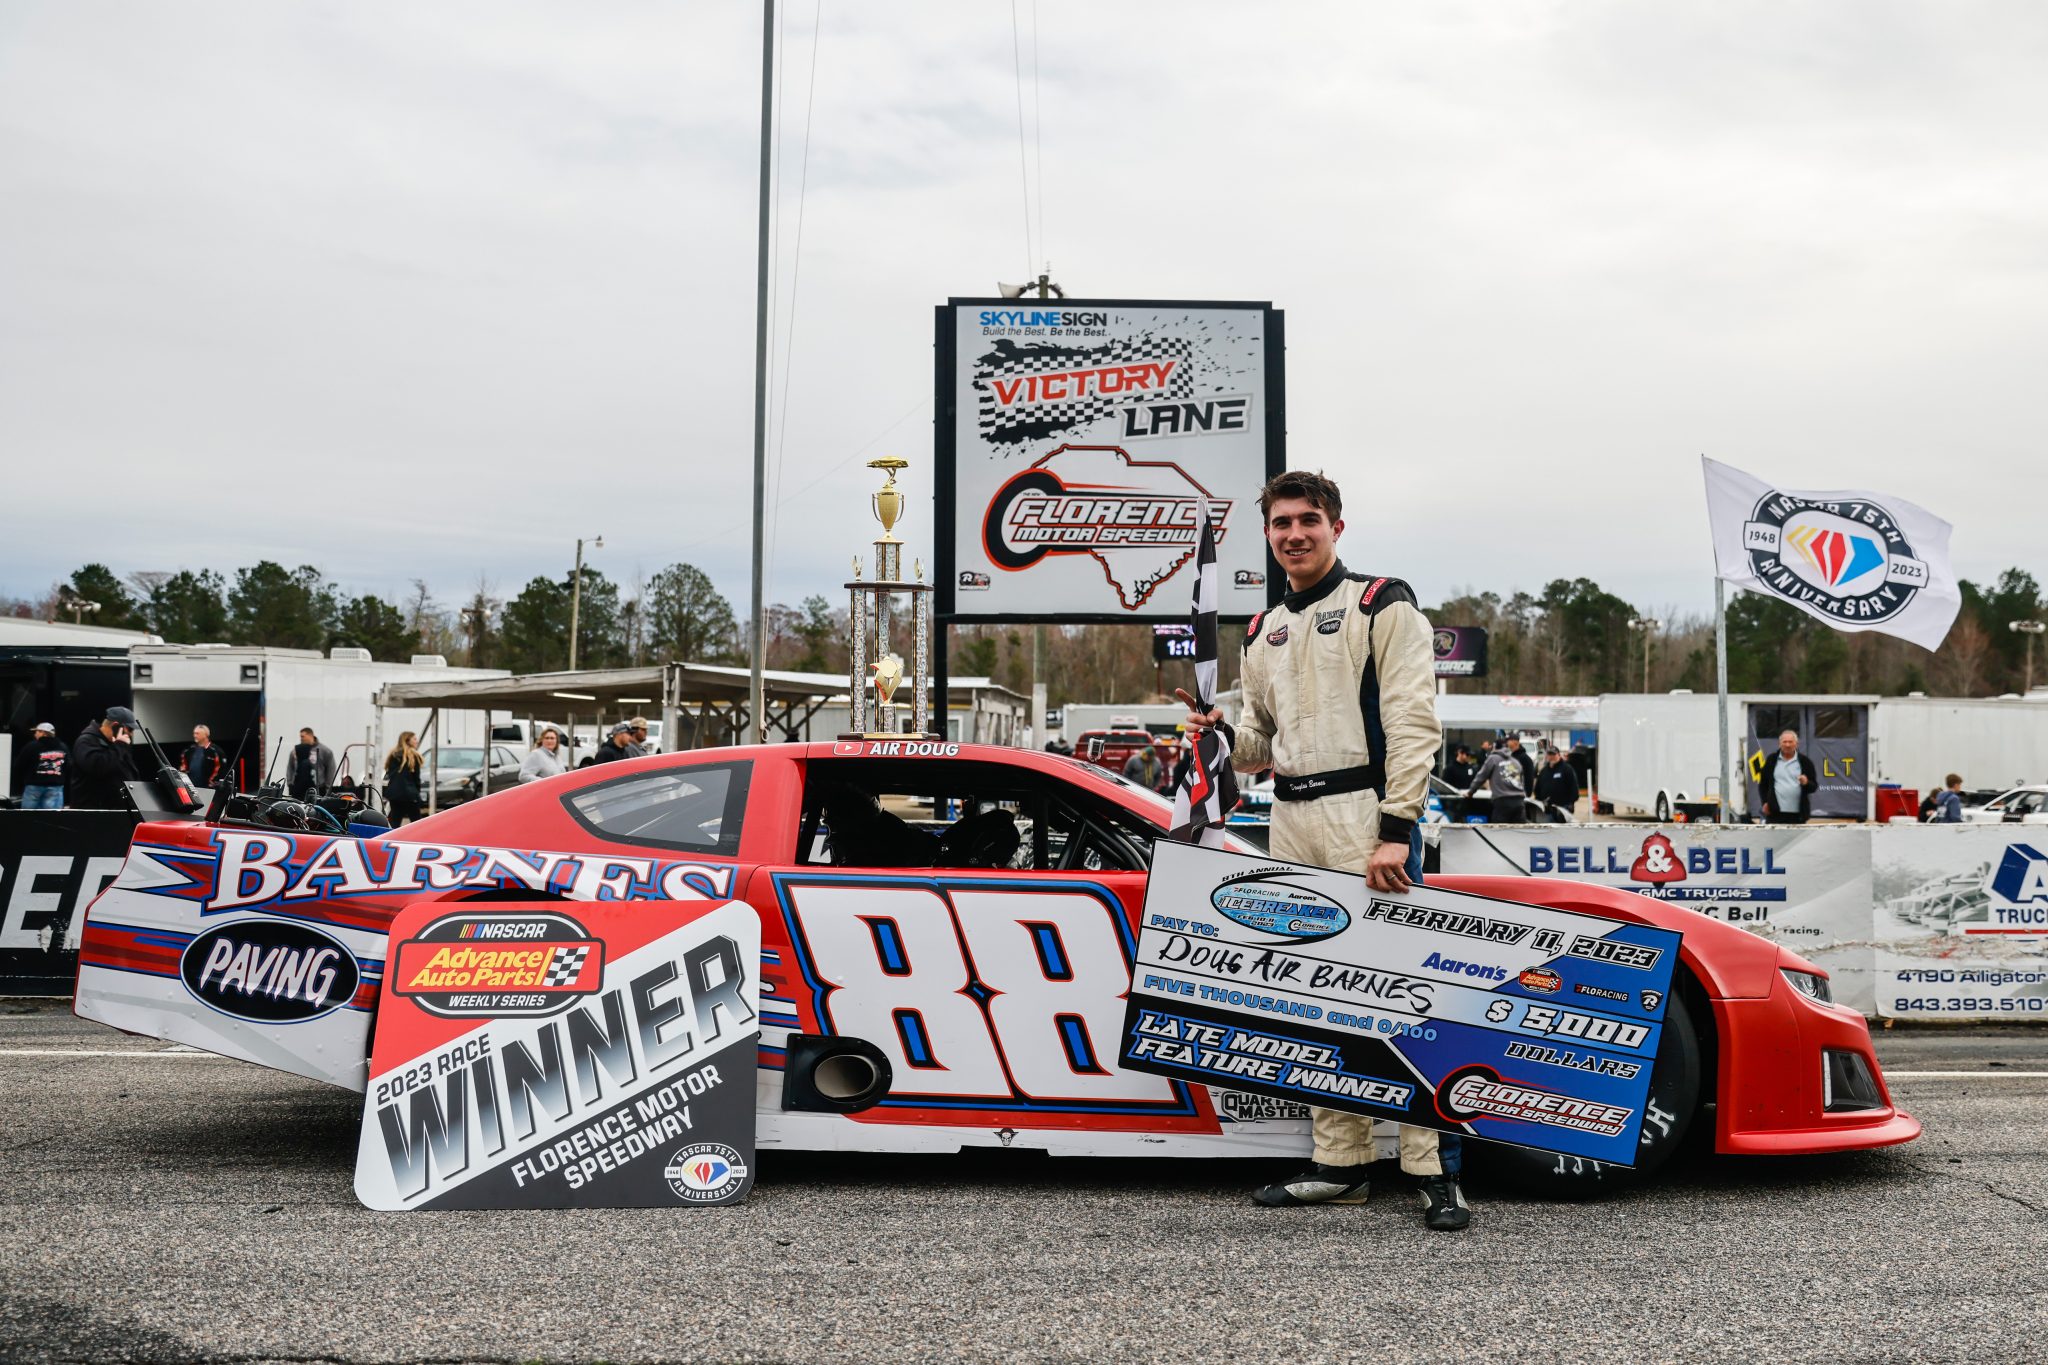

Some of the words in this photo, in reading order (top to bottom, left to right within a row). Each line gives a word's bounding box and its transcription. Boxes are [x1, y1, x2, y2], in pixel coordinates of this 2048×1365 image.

[979, 311, 1107, 327] SKYLINESIGN
[982, 326, 1006, 336] Build
[1007, 326, 1021, 336] the
[1024, 327, 1047, 336] Best.
[1050, 328, 1064, 336] Be
[1065, 328, 1081, 337] the
[1083, 328, 1108, 337] Best.
[991, 360, 1178, 406] VICTORY
[1121, 399, 1248, 438] LANE
[1010, 499, 1234, 527] FLORENCE
[1849, 503, 1902, 544] 75TH
[1012, 526, 1098, 543] MOTOR
[1099, 527, 1226, 544] SPEEDWY
[1749, 530, 1776, 544] 1948
[1891, 563, 1922, 577] 2023
[869, 742, 902, 756] AIR
[904, 742, 959, 757] DOUG
[206, 831, 732, 910] BARNES
[1247, 866, 1294, 875] ANNUAL
[1529, 846, 1629, 874] BELL
[1645, 844, 1673, 874] &
[1687, 846, 1786, 875] BELL
[1287, 892, 1318, 902] Aaron's
[1638, 887, 1676, 898] GMC
[1682, 888, 1752, 898] TRUCKS
[1220, 896, 1340, 921] ICEBREAKER
[1727, 906, 1769, 921] Bell
[1995, 908, 2048, 924] TRUC
[480, 923, 547, 938] NASCAR
[1151, 914, 1190, 931] PAY
[1191, 922, 1220, 938] TO:
[1364, 898, 1534, 945] FEBRUARY
[1532, 929, 1565, 957] 11,
[1567, 935, 1664, 971] 2023
[1783, 926, 1825, 936] racing.
[427, 946, 542, 967] Advance
[1421, 951, 1508, 981] Aaron's
[200, 937, 340, 1008] PAVING
[408, 968, 471, 988] Auto
[471, 967, 537, 986] Parts
[1250, 950, 1302, 983] AIR
[1310, 964, 1434, 1013] BARNES
[448, 994, 500, 1007] WEEKLY
[500, 994, 547, 1007] SERIES
[789, 886, 1178, 1101] 88
[1144, 974, 1195, 997] FIVE
[1199, 985, 1323, 1021] THOUSAND
[1327, 1011, 1374, 1030] and
[1580, 985, 1628, 1001] FLORACING
[1894, 998, 2048, 1012] 843.393.510
[1485, 999, 1514, 1024] $
[1520, 1004, 1652, 1051] 5,000
[1135, 1012, 1227, 1047] LATE
[1229, 1030, 1340, 1070] MODEL
[376, 1062, 433, 1106] 2023
[437, 1033, 491, 1076] RACE
[377, 934, 757, 1202] WINNER
[1504, 1041, 1642, 1080] DOLLARS
[1132, 1037, 1283, 1082] FEATURE
[1286, 1064, 1412, 1111] WINNER
[1224, 1094, 1312, 1111] QUAR
[1239, 1105, 1312, 1118] MASTER
[1456, 1080, 1631, 1124] FLORENCE
[510, 1111, 636, 1188] FLORENCE
[637, 1063, 724, 1128] MOTOR
[1456, 1096, 1519, 1116] MOTOR
[1521, 1108, 1623, 1135] SPEEDWAY
[562, 1105, 694, 1190] SPEEDWAY
[676, 1145, 712, 1163] NASCAR
[714, 1145, 737, 1163] 75TH
[673, 1178, 737, 1199] ANNIVERSARY
